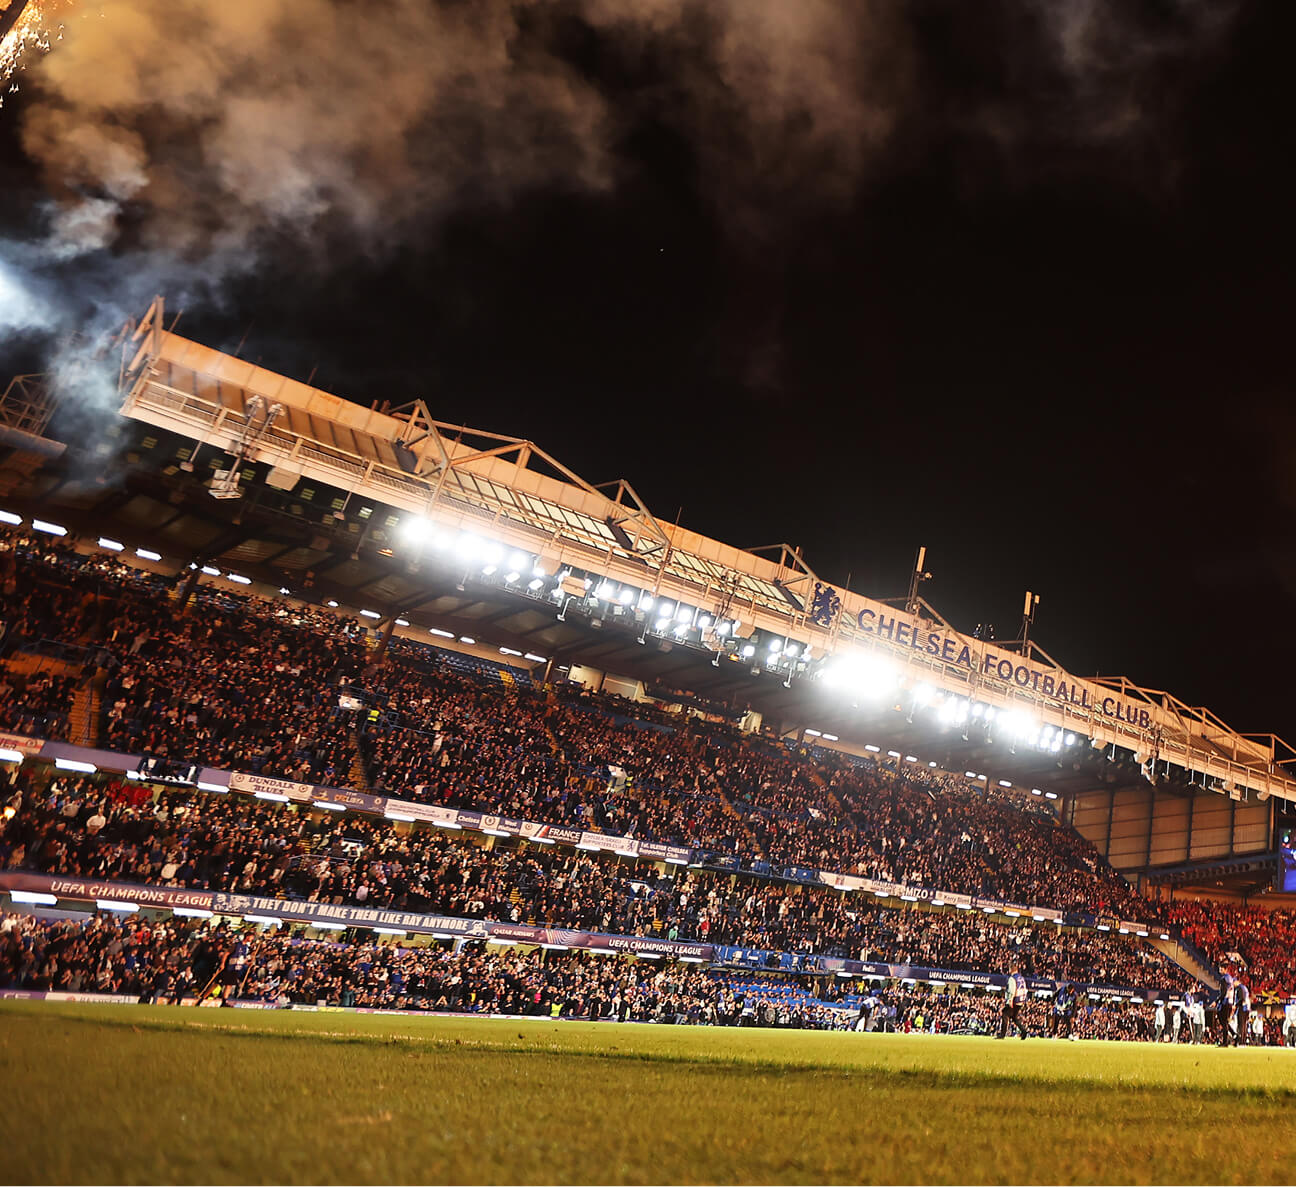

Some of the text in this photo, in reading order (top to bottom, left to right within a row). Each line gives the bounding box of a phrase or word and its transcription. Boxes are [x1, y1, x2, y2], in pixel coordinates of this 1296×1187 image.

[857, 608, 1150, 729] CHELSEA FOOTBALL CLUB
[249, 776, 295, 789] DUNDALK
[253, 784, 284, 795] BLUES
[548, 828, 581, 840] FRANCE
[51, 881, 85, 894] UEFA
[89, 885, 166, 902] CHAMPIONS
[167, 893, 213, 907] LEAGUE
[905, 887, 928, 899] MIZO
[252, 897, 282, 910] THEY
[281, 901, 318, 915] DON'T
[317, 904, 348, 919] MAKE
[349, 909, 379, 922] THEM
[378, 912, 402, 924] LIKE
[402, 915, 422, 927] RAY
[421, 917, 469, 930] ANYMORE
[493, 928, 513, 936] QATAR
[608, 939, 703, 955] UEFA CHAMPIONS LEAGUE
[928, 971, 991, 984] UEFA CHAMPIONS LEAGUE
[1086, 986, 1134, 997] UEFA CHAMPIONS LEAGUE
